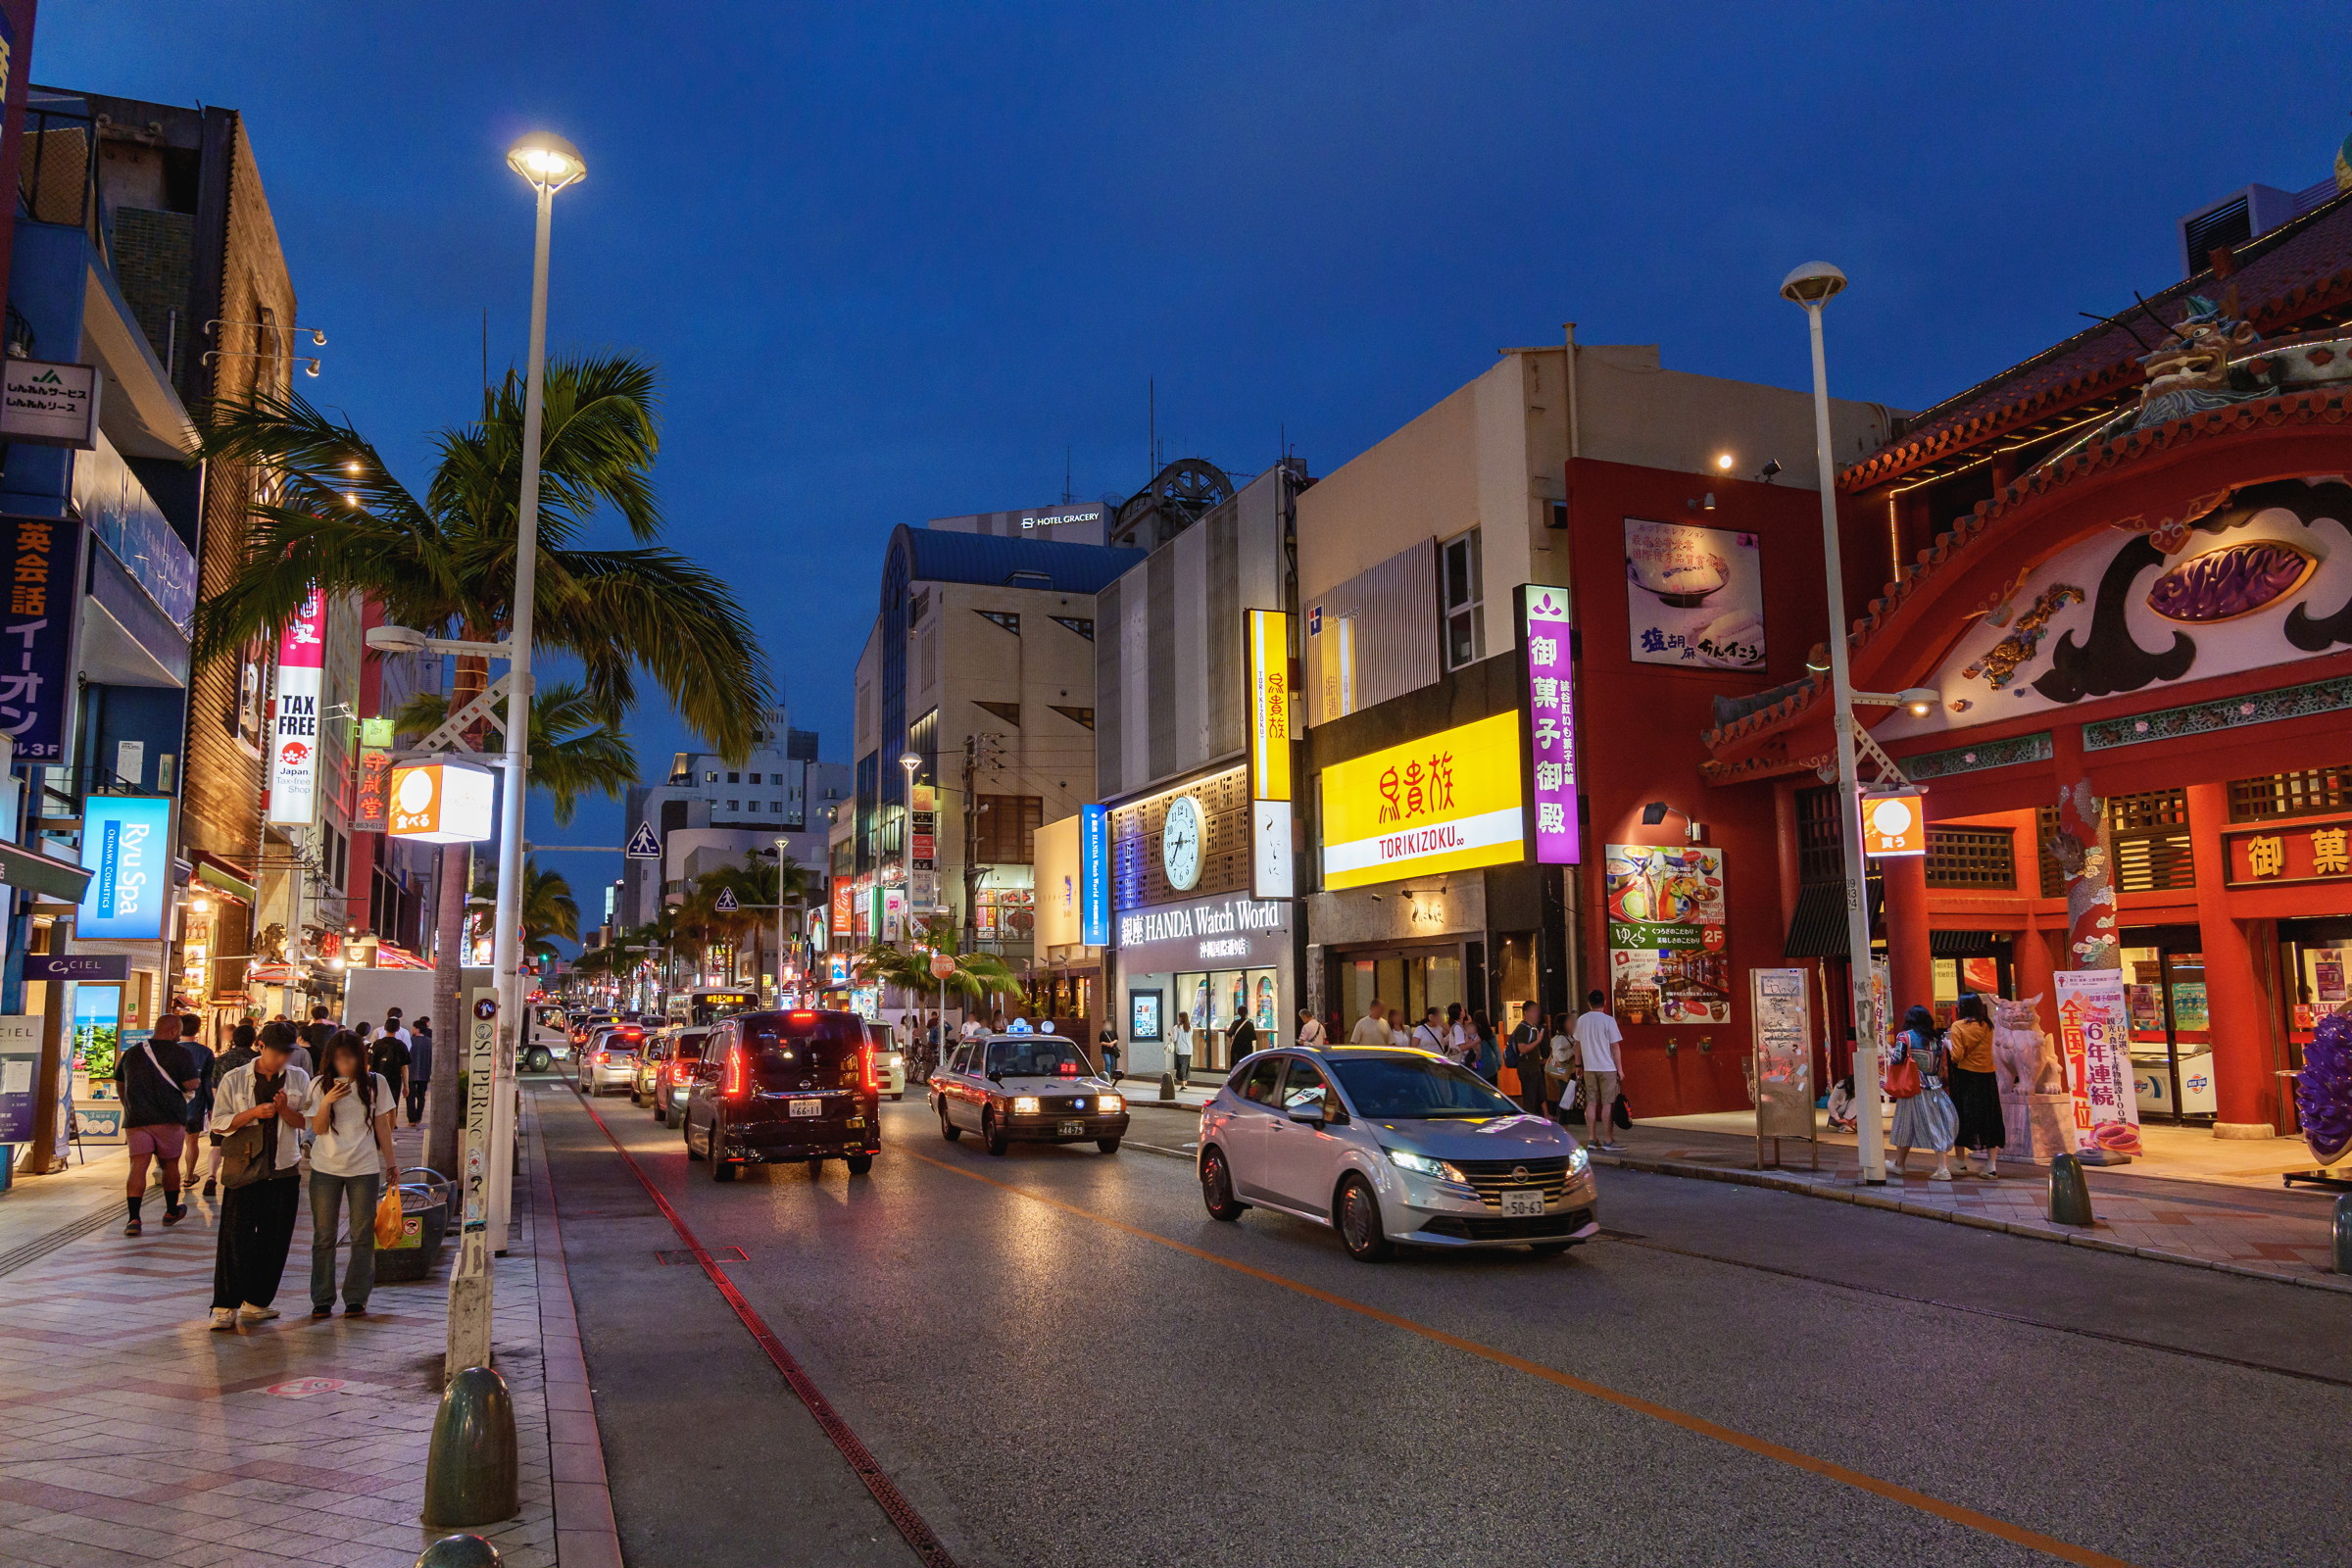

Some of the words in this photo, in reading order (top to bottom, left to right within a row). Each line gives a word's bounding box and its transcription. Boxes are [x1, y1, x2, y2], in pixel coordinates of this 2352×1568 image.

[6, 397, 76, 413] しんれんリース
[7, 383, 87, 400] しんれんサービス
[1037, 517, 1062, 526] HOTEL
[1063, 513, 1099, 523] GRACERY
[11, 522, 54, 616] 英会話
[0, 618, 48, 736] イーオン
[282, 695, 315, 715] TAX
[1268, 672, 1285, 738] 鳥貴族
[278, 715, 316, 736] FREE
[1531, 635, 1566, 834] 御菓子御殿
[276, 777, 311, 786] Tax-free
[288, 785, 311, 795] Shop
[1378, 751, 1455, 825] 鳥貴族
[105, 828, 116, 865] OKINAWA
[119, 823, 150, 867] Ryu
[1379, 825, 1455, 859] TORIKIZOKU
[2247, 827, 2351, 877] 御菓
[102, 866, 113, 908] COSMETICS
[115, 871, 146, 915] Spa
[1121, 914, 1145, 947] 銀座
[1145, 909, 1194, 941] HANDA
[1195, 902, 1235, 934] Watch
[1236, 899, 1280, 930] World
[1615, 926, 1646, 949] ゆくら
[1704, 930, 1723, 943] 2F
[70, 960, 102, 969] CIEL
[2314, 1004, 2330, 1013] TAX
[2060, 999, 2095, 1131] 全国1位
[2086, 1022, 2115, 1106] 6年連続
[796, 1106, 819, 1115] 66-11
[1510, 1200, 1543, 1214] 50-63
